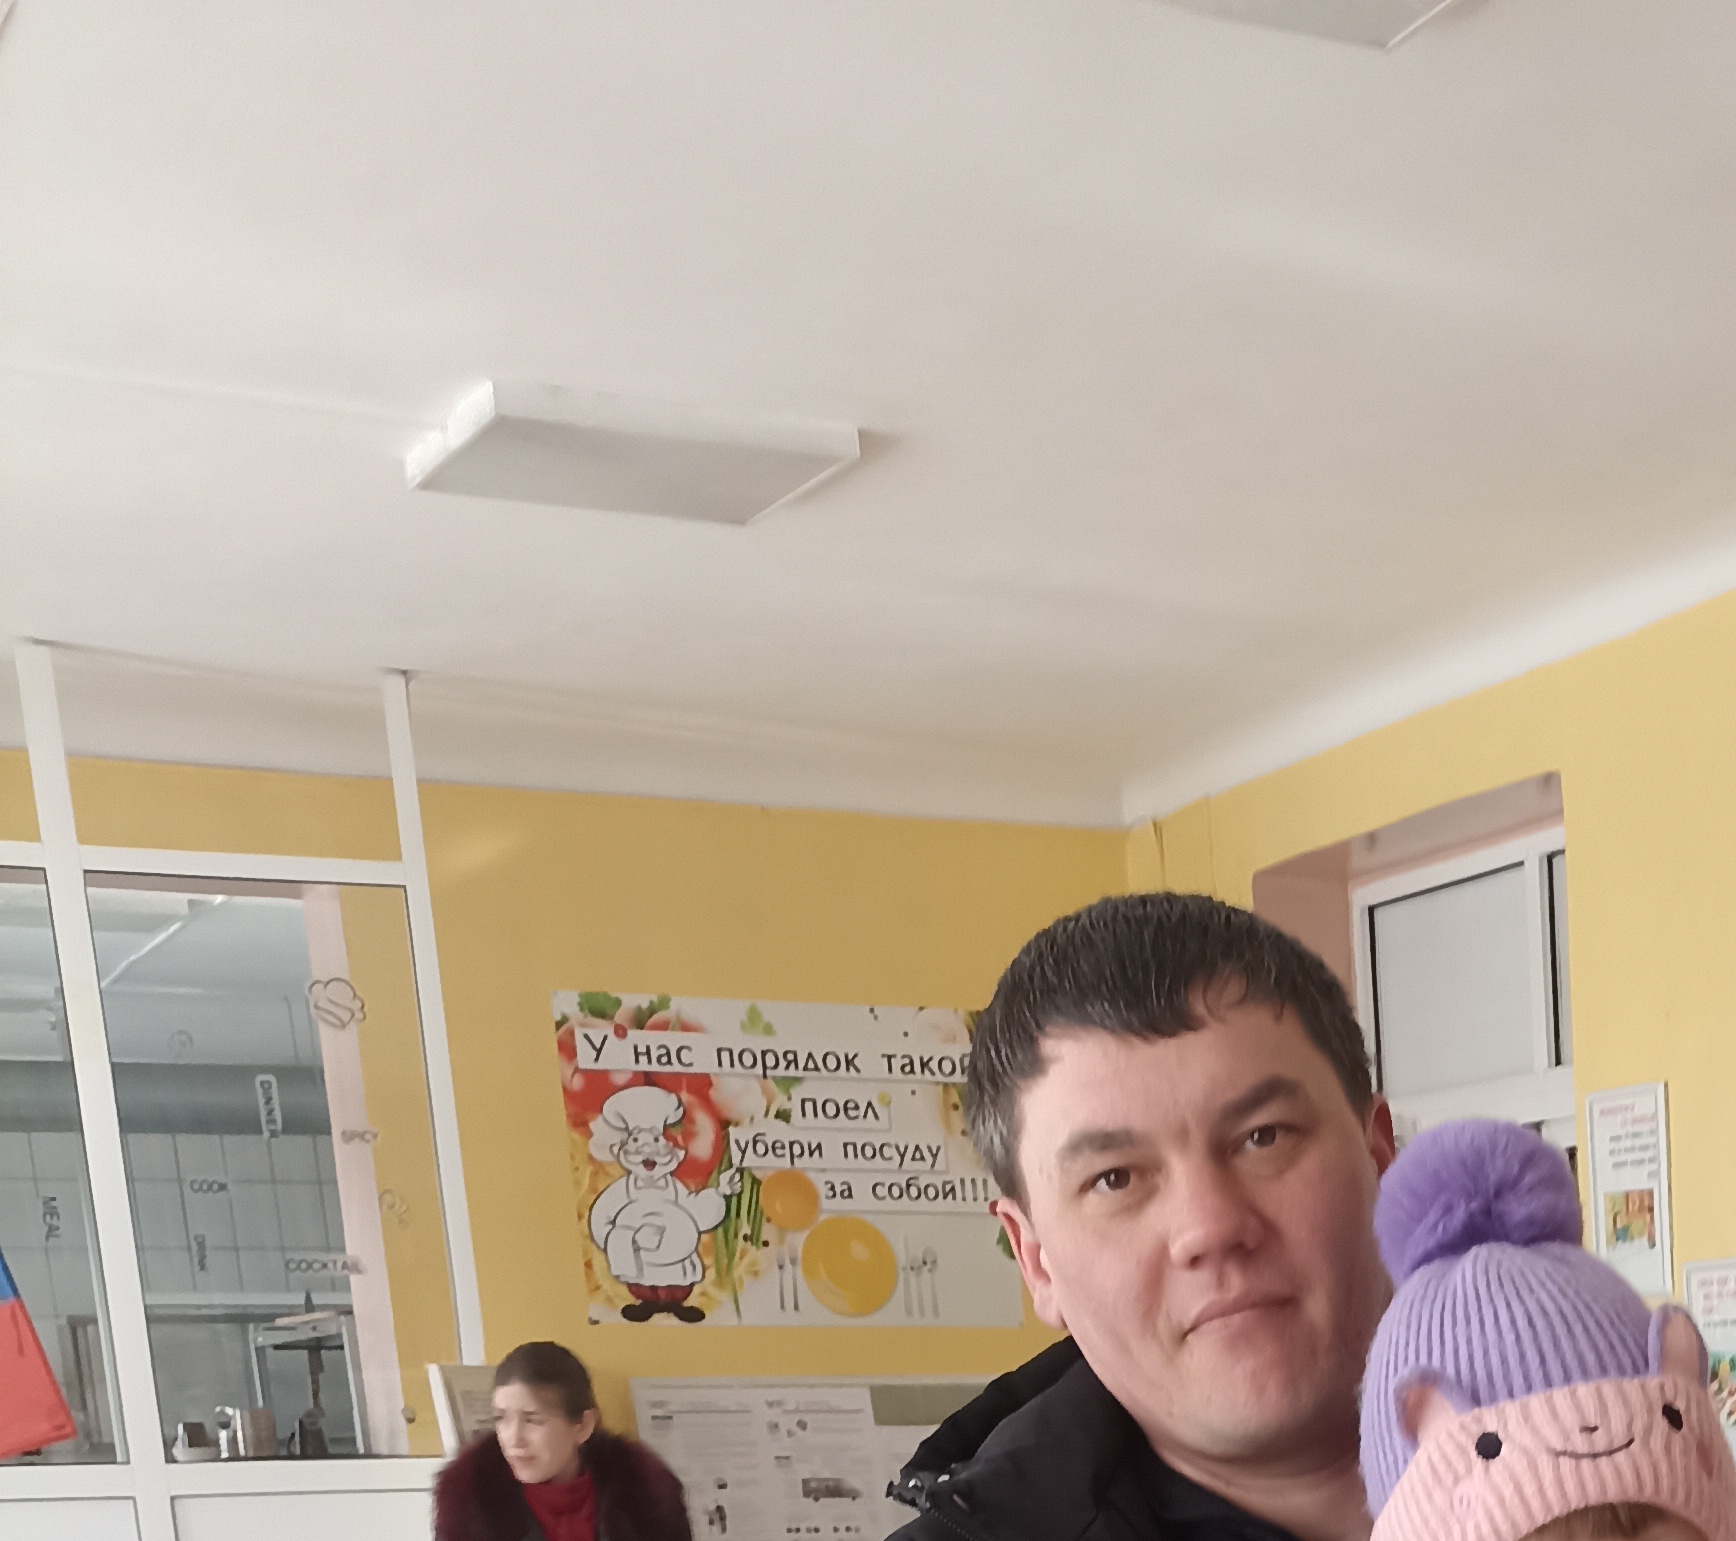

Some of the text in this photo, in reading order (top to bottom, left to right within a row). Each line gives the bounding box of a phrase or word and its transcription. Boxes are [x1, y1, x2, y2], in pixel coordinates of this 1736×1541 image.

[583, 1033, 608, 1063] У
[633, 1043, 694, 1067] нас
[716, 1046, 862, 1079] порядок
[800, 1098, 880, 1121] поел
[734, 1132, 941, 1169] убери посуду
[824, 1176, 989, 1202] за собой!!!
